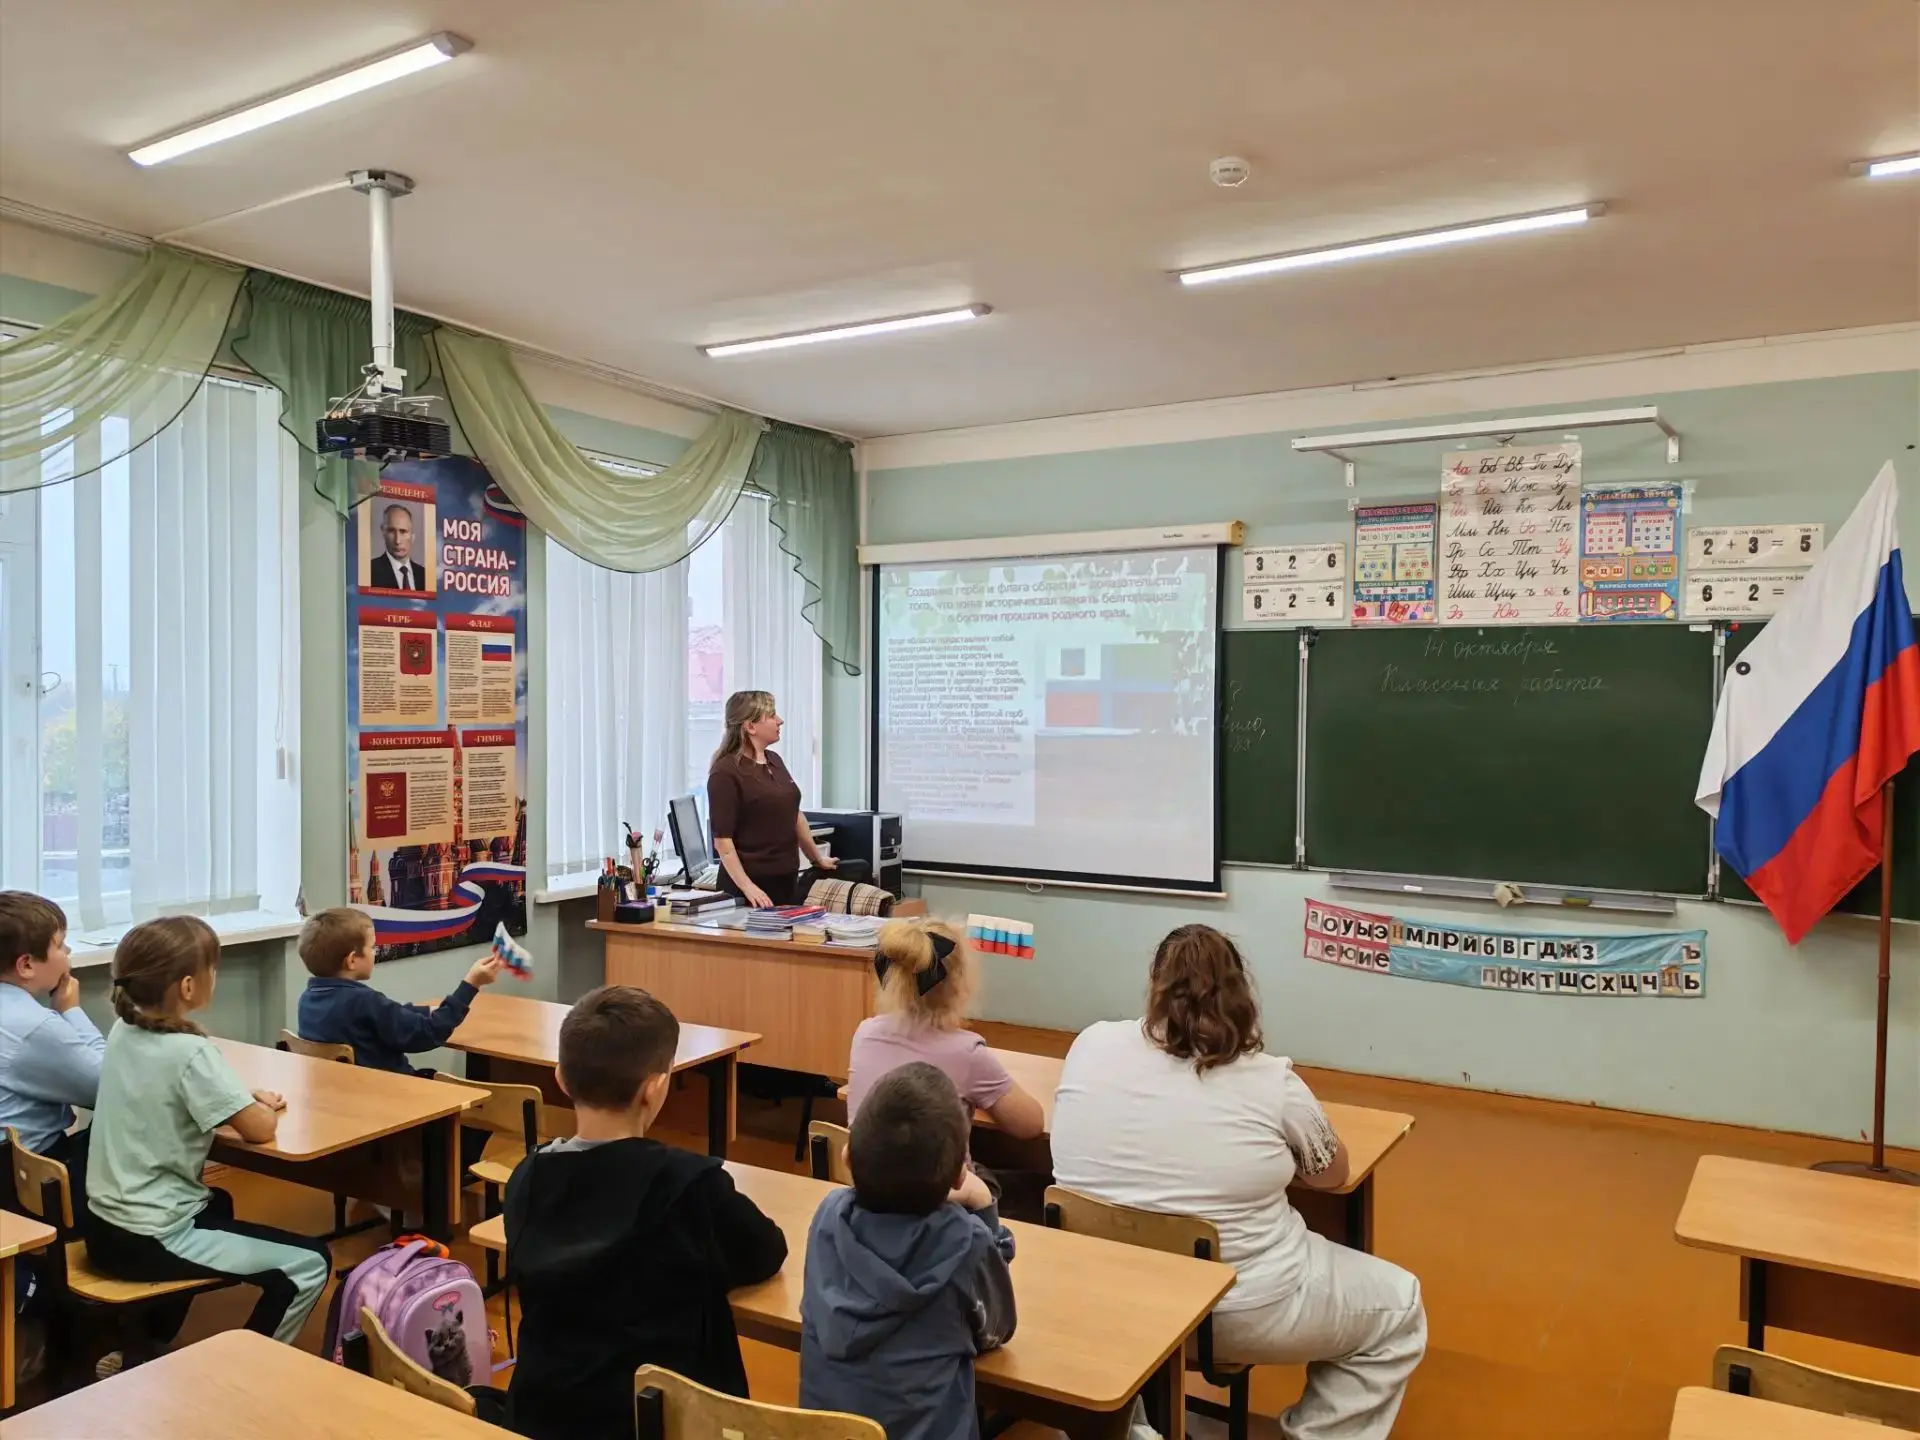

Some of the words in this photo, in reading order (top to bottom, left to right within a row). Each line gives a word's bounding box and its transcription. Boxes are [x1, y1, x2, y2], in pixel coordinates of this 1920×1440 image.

[1480, 456, 1504, 473] Бб
[1504, 456, 1524, 472] Вв
[1553, 453, 1574, 473] Дд
[1500, 478, 1538, 493] Жж
[443, 518, 481, 542] МОЯ
[1487, 519, 1509, 536] Нн
[1546, 516, 1573, 533] Пп
[1446, 542, 1466, 563] Рр
[1479, 541, 1495, 556] Сс
[1507, 539, 1542, 555] Тт
[1703, 538, 1713, 555] 2
[1748, 536, 1758, 553] 3
[1800, 535, 1811, 552] 5
[443, 545, 516, 571] СТРАНА-
[1256, 556, 1264, 571] 3
[1288, 555, 1296, 570] 2
[1327, 553, 1336, 568] 6
[1477, 561, 1505, 577] Хх
[1515, 560, 1539, 580] Цц
[1550, 559, 1568, 575] Чч
[444, 571, 510, 596] РОССИЯ
[1448, 584, 1476, 599] Шш
[1702, 585, 1712, 602] 6
[1748, 584, 1759, 601] 2
[1254, 595, 1262, 610] 8
[1288, 593, 1297, 608] 2
[1326, 592, 1335, 607] 4
[1493, 602, 1519, 618] Юю
[1549, 601, 1572, 618] Яя
[1454, 632, 1559, 664] октября
